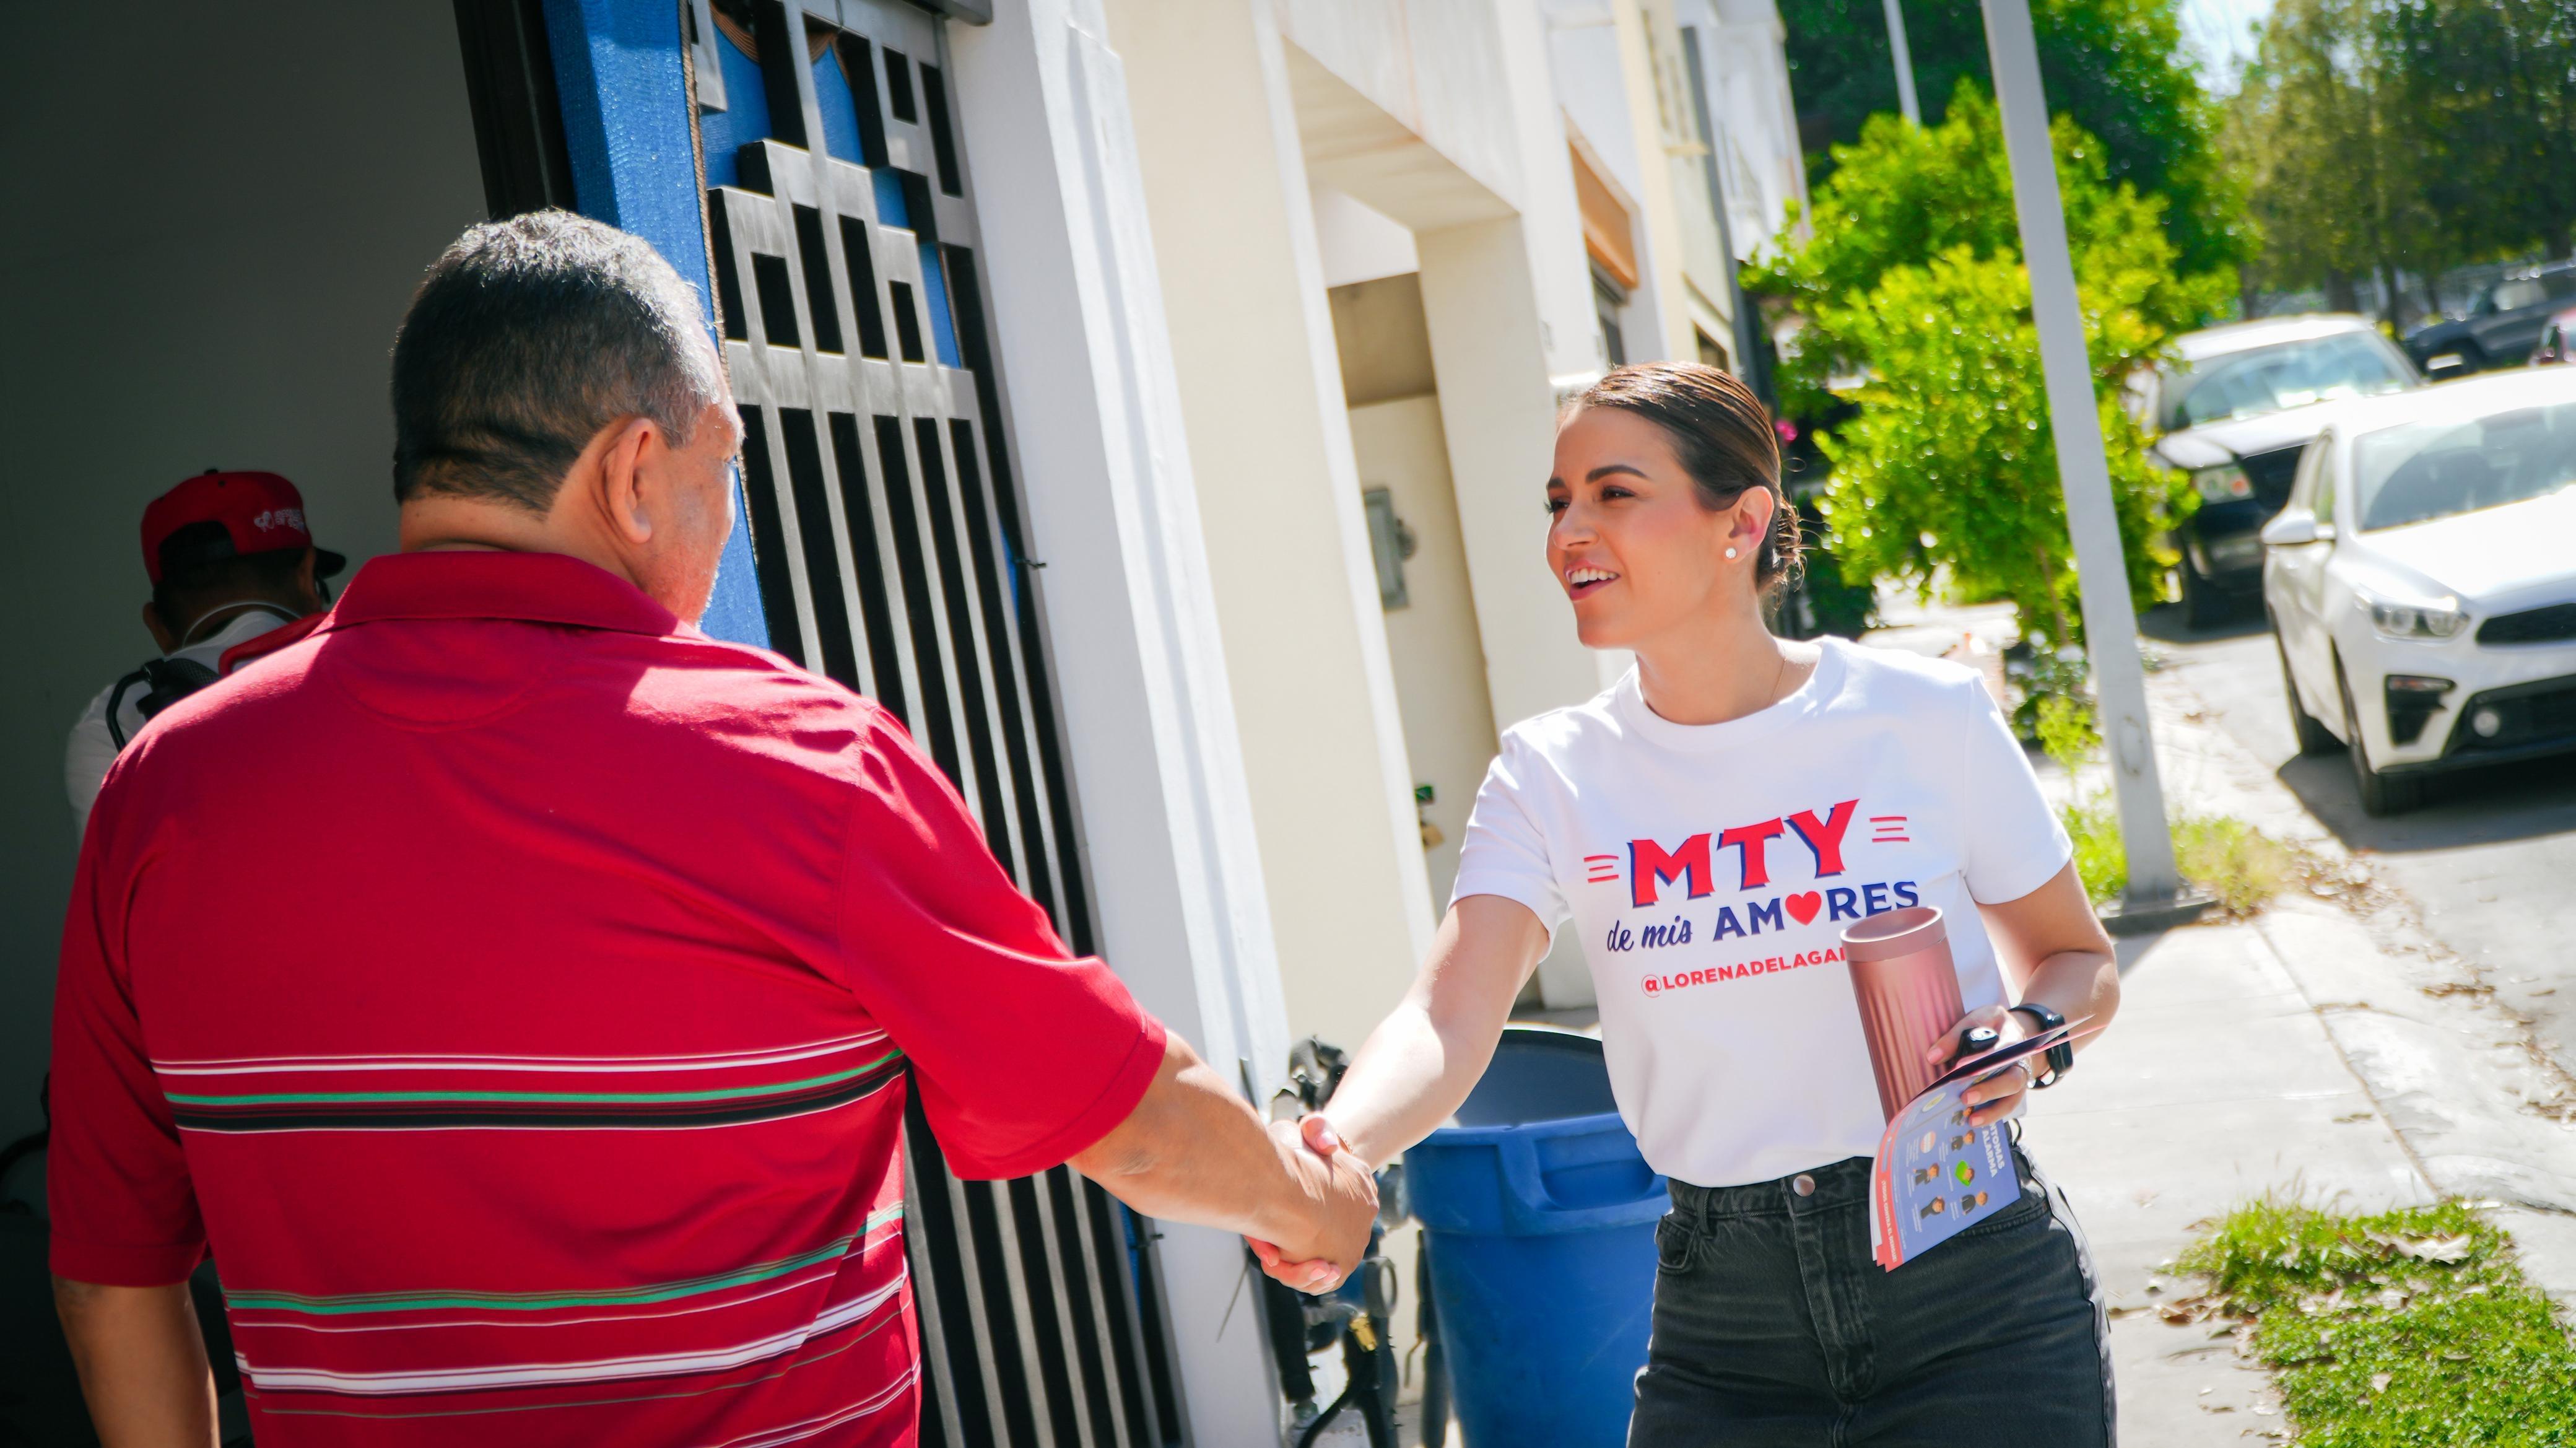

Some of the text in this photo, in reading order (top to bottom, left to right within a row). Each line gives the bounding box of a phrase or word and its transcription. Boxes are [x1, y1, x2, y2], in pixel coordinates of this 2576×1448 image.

[1627, 798, 1860, 909] MTY
[1607, 920, 1634, 953] de
[1641, 915, 1693, 949] mis
[1982, 1130, 1998, 1178] ALARMA
[1990, 1123, 2005, 1169] NTOMAS
